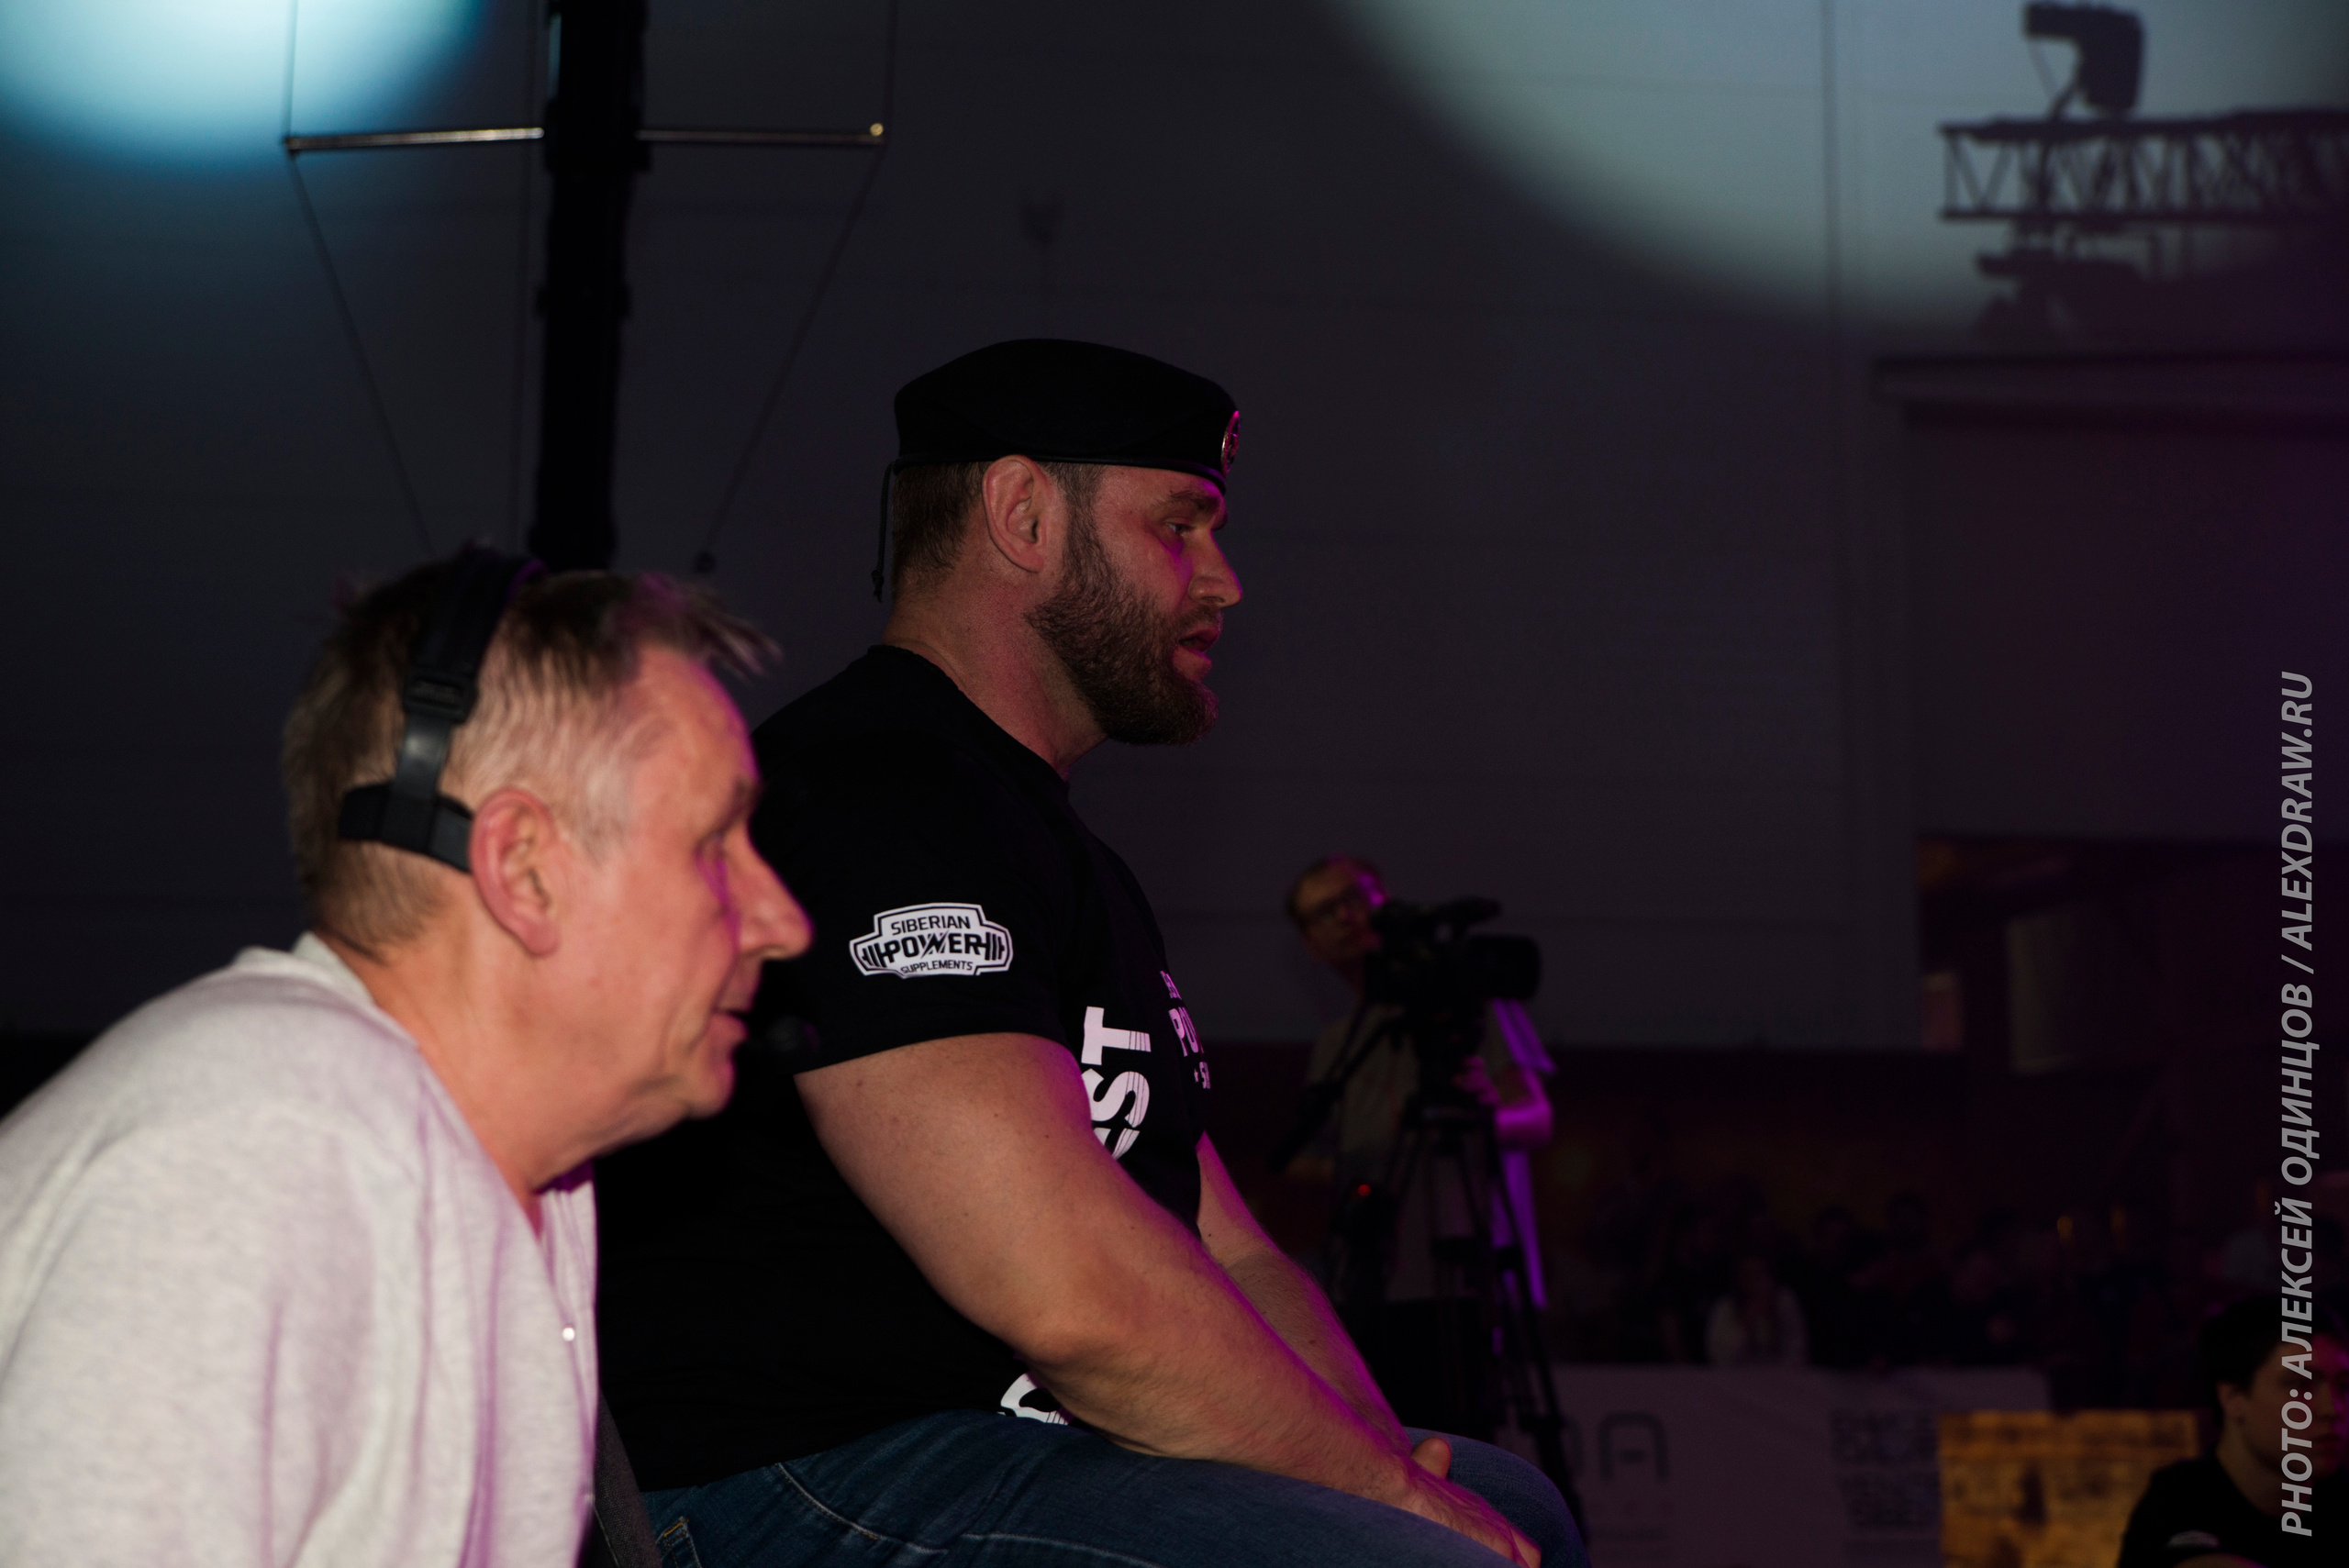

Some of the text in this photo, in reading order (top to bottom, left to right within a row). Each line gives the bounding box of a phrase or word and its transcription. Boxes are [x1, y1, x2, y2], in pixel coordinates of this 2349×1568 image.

[891, 915, 971, 936] SIBERIAN
[884, 930, 982, 963] POWER
[900, 959, 974, 974] SUPPLEMENTS
